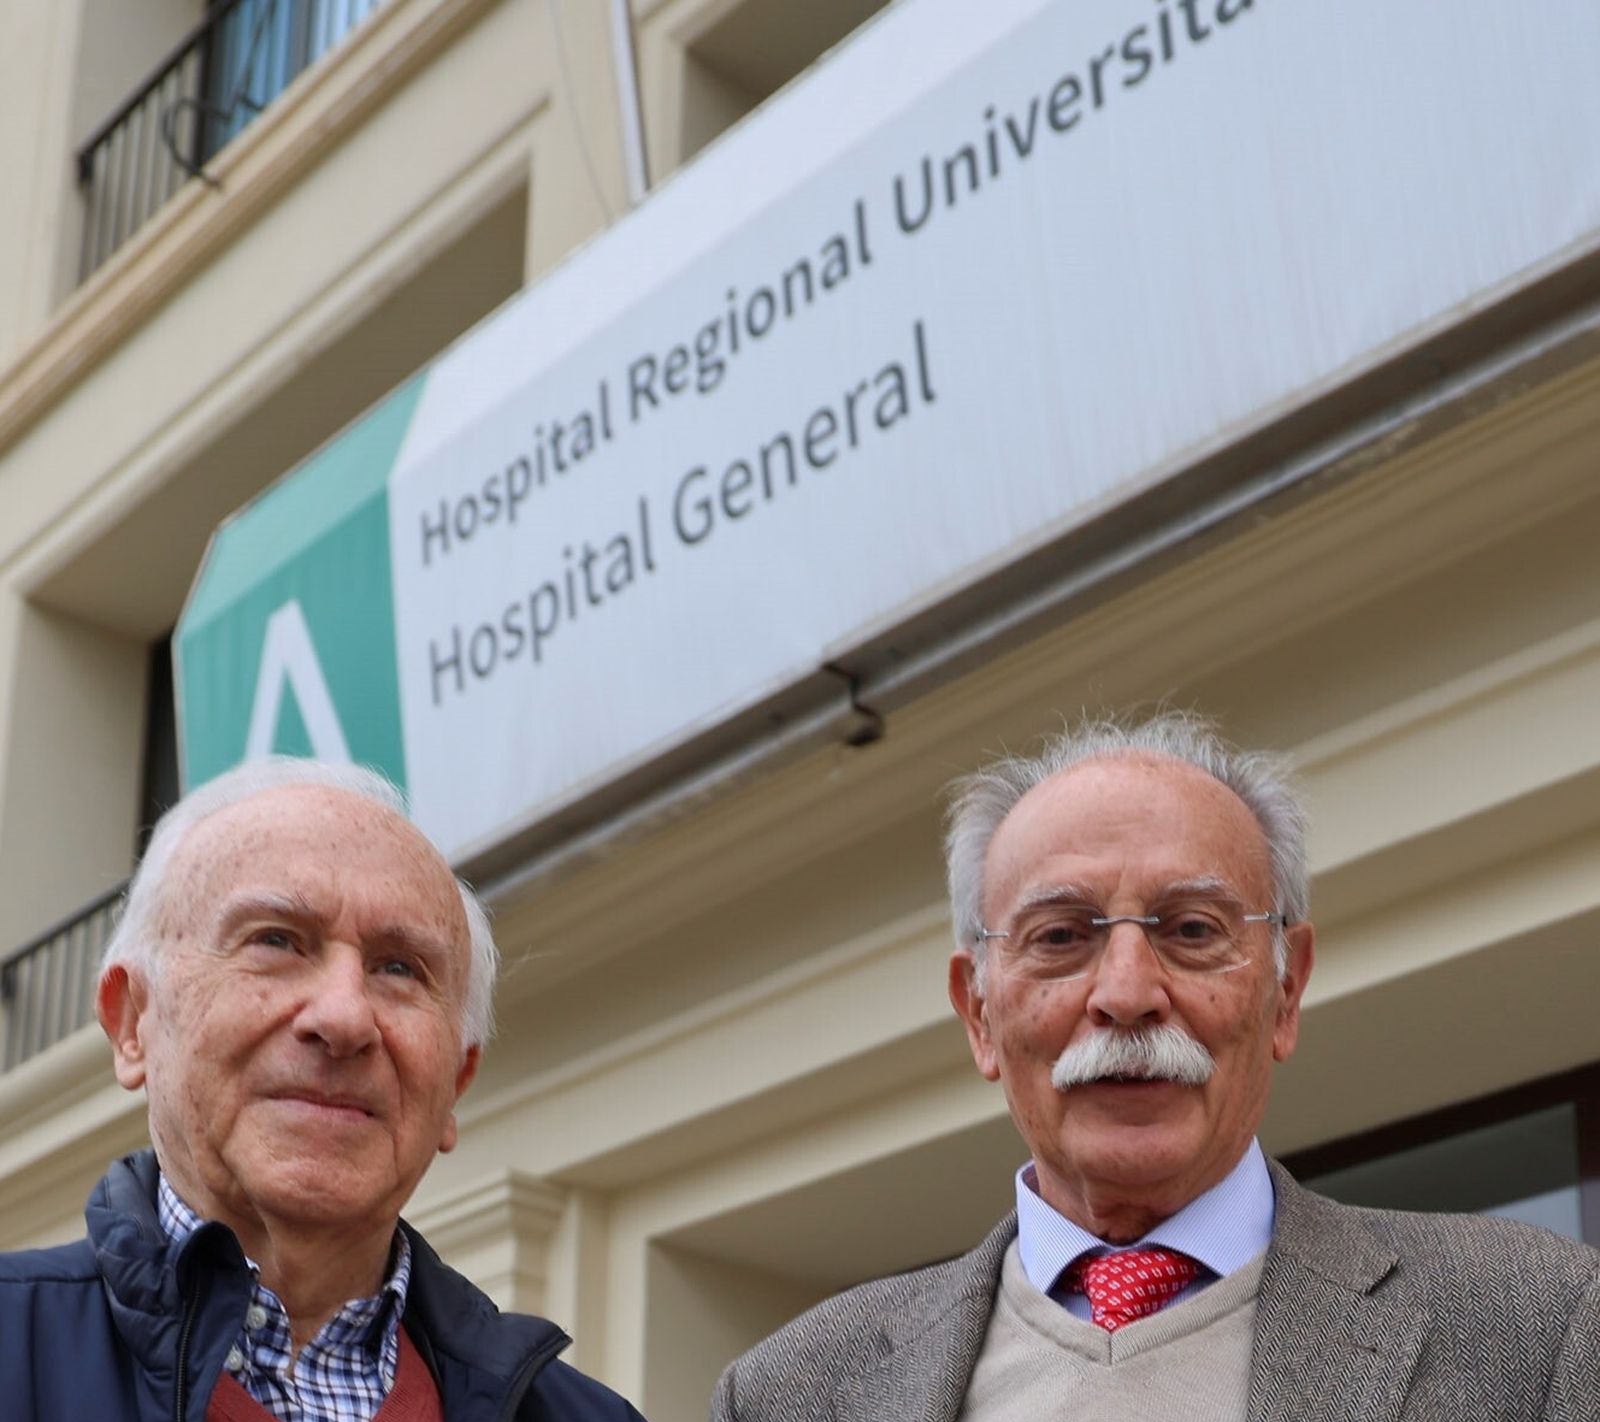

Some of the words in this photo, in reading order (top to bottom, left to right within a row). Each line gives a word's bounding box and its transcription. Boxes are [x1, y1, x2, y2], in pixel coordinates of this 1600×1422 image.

[420, 377, 615, 567] Hospital
[627, 197, 874, 422] Regional
[427, 496, 657, 704] Hospital
[672, 320, 938, 547] General
